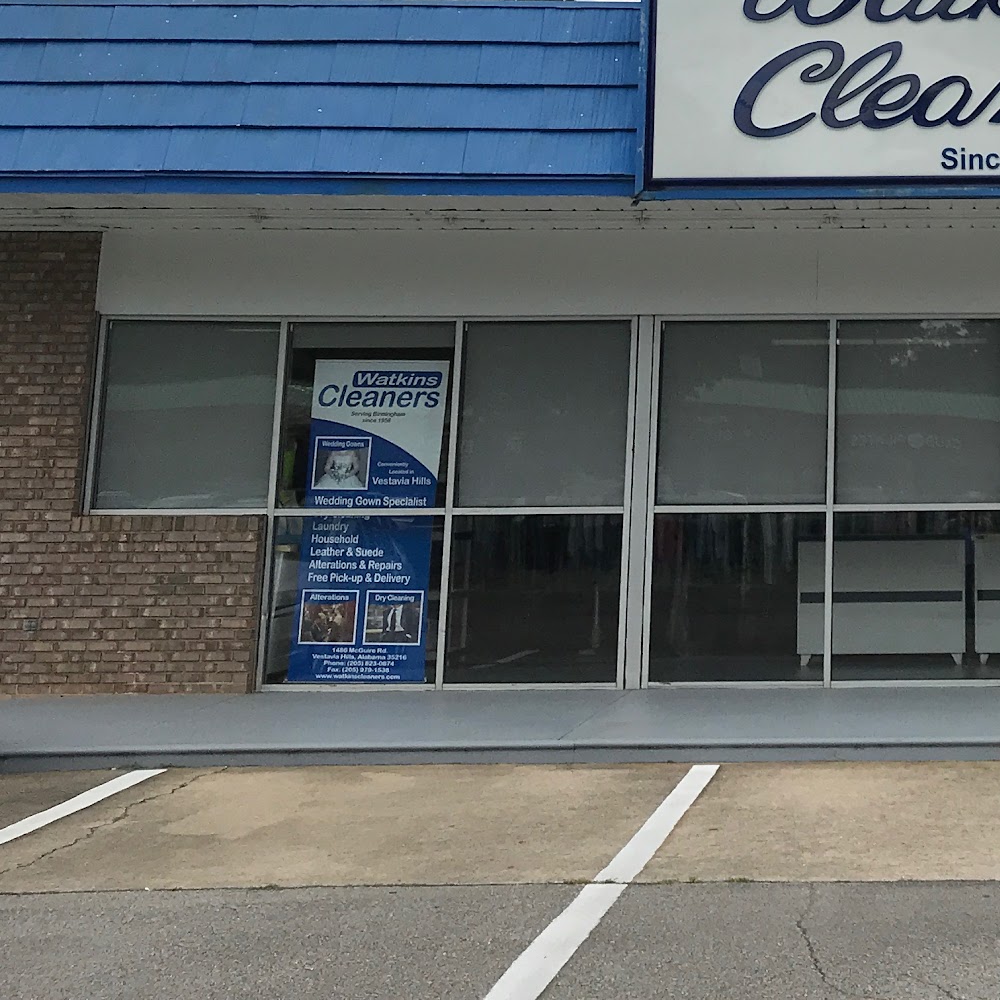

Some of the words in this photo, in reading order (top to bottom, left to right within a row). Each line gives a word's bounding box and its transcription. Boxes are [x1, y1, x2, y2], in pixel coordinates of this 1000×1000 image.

[357, 372, 439, 386] Watkins
[318, 384, 440, 408] Cleaners
[322, 440, 346, 448] Wedding
[372, 476, 410, 485] Vestavia
[411, 476, 432, 485] Hills
[314, 495, 354, 507] Wedding
[355, 496, 381, 506] Gown
[383, 496, 427, 508] Specialist
[312, 521, 349, 533] Laundry
[311, 533, 359, 544] Household
[310, 546, 345, 557] Leather
[346, 547, 353, 557] &
[355, 547, 384, 557] Suede
[308, 560, 357, 569] Alterations
[359, 560, 366, 570] &
[368, 560, 402, 572] Repairs
[307, 572, 328, 582] Free
[329, 573, 363, 584] Pick-up
[364, 573, 372, 583] &
[373, 573, 411, 585] Delivery
[309, 593, 350, 601] Alterations
[375, 594, 387, 602] Dry
[387, 594, 415, 602] Cleaning
